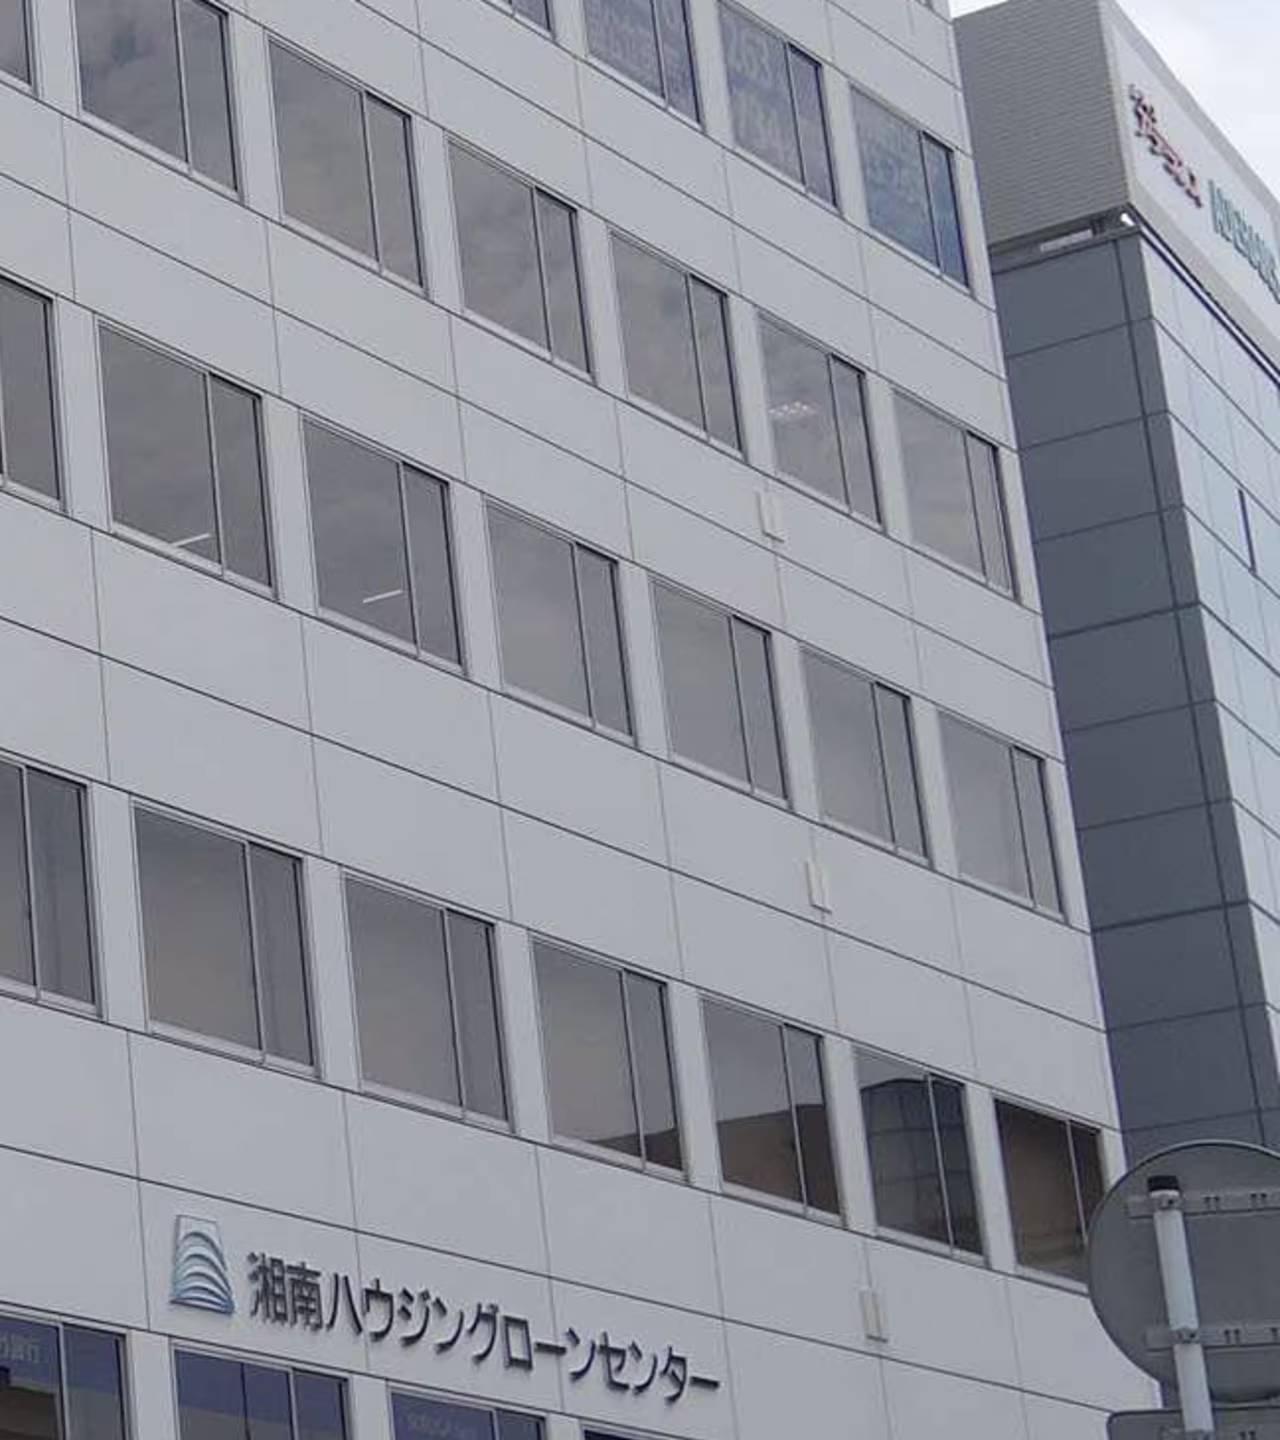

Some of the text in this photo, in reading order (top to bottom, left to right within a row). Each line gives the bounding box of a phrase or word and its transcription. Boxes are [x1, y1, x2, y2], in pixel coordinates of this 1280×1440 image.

[246, 1251, 721, 1405] 湘南ハウジングローンセンター
